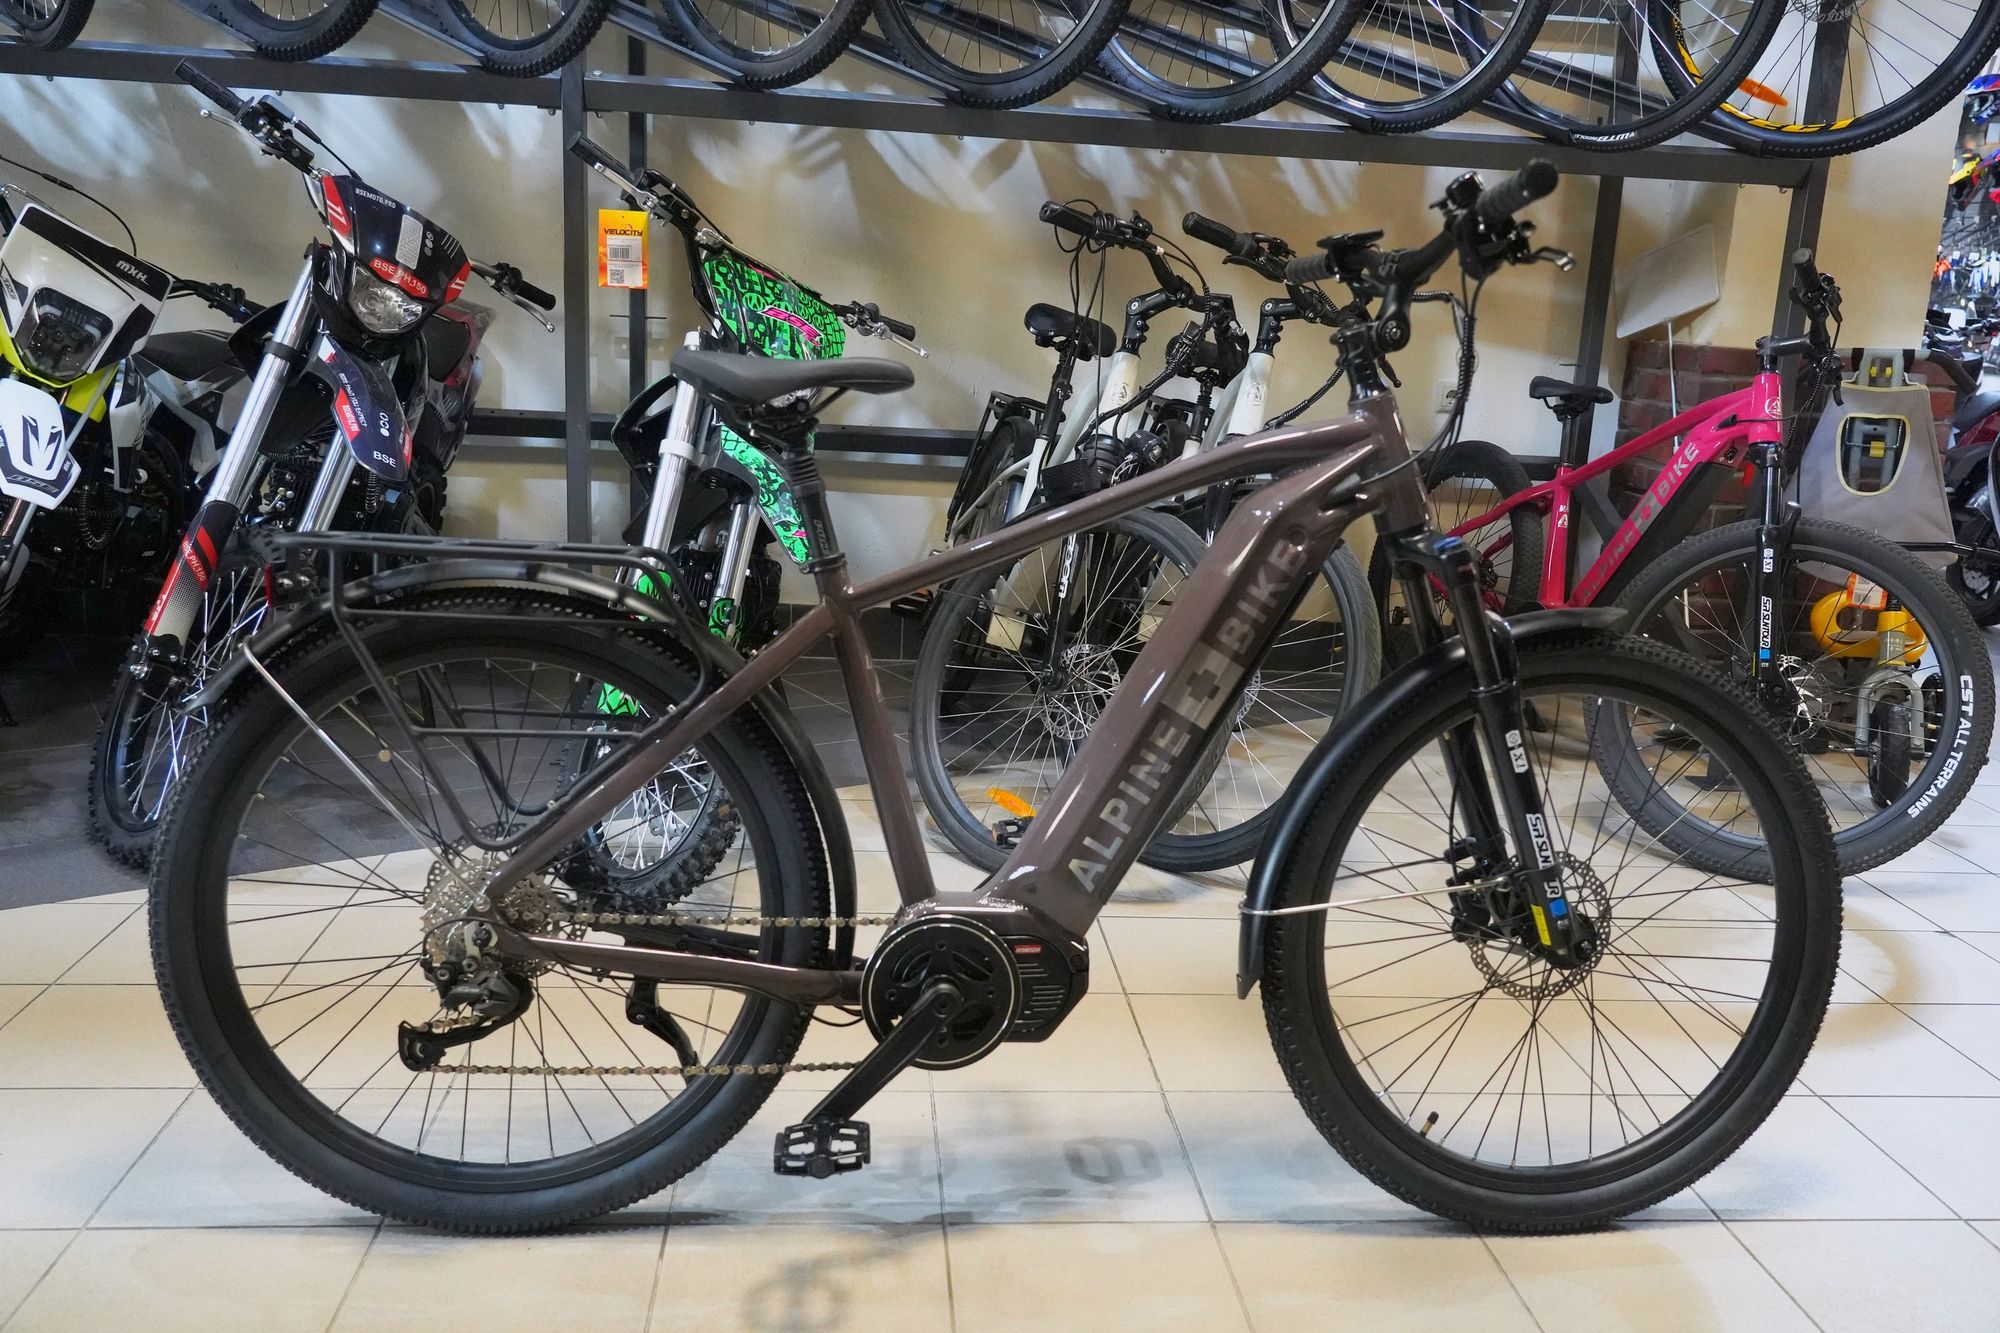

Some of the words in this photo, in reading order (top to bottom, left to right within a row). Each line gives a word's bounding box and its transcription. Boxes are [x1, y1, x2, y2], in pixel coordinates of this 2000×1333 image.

[604, 227, 643, 237] VELOCITY
[373, 450, 397, 468] BSE
[1657, 441, 1700, 499] BIKE
[1761, 596, 1772, 613] SR
[1761, 612, 1772, 649] SUNTOUR
[1959, 674, 1975, 717] CST
[1068, 718, 1192, 893] ALPINE
[1216, 537, 1302, 659] BIKE
[1953, 717, 1972, 748] ALL
[1907, 750, 1964, 819] TERRAINS
[1527, 814, 1547, 840] SR
[1535, 839, 1563, 898] SUNUR
